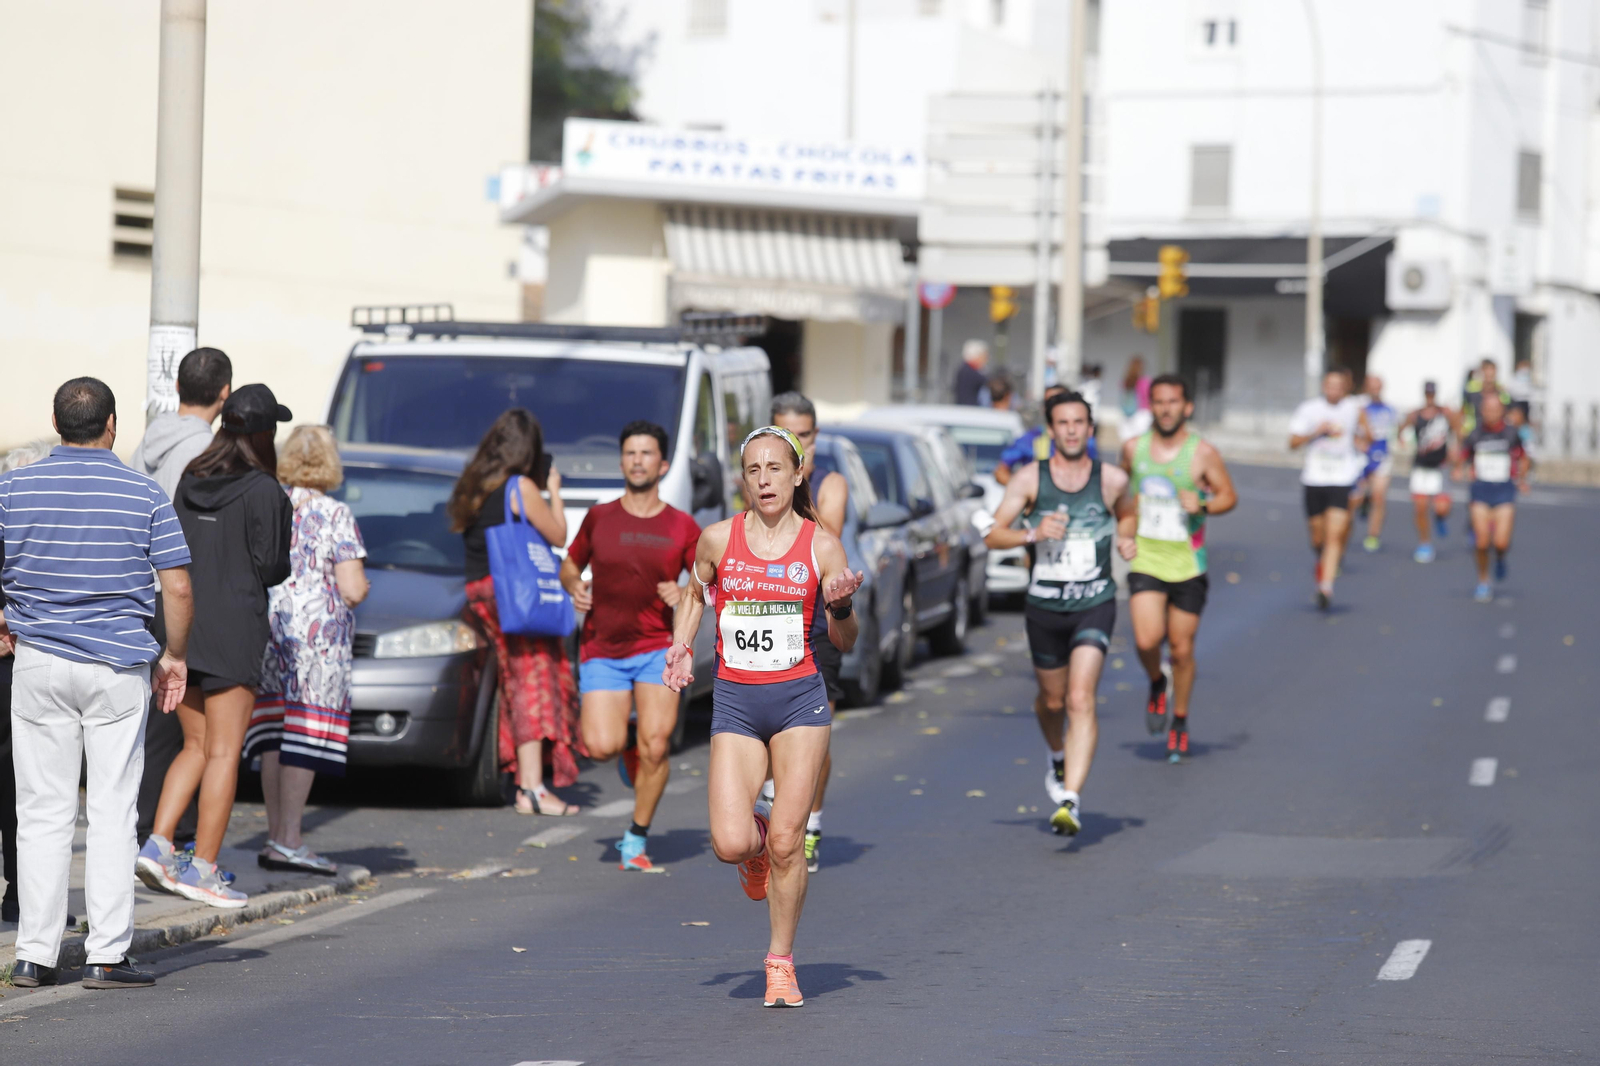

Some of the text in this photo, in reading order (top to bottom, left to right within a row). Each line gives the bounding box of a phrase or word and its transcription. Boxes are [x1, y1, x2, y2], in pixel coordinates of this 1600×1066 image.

[608, 131, 749, 157] CHURROS
[649, 160, 896, 189] PATATAS FRITAS
[757, 582, 807, 596] FERTILIDAD
[737, 605, 761, 614] VUELTA
[762, 605, 768, 614] A
[769, 604, 797, 614] HUELVA
[735, 629, 774, 652] 645
